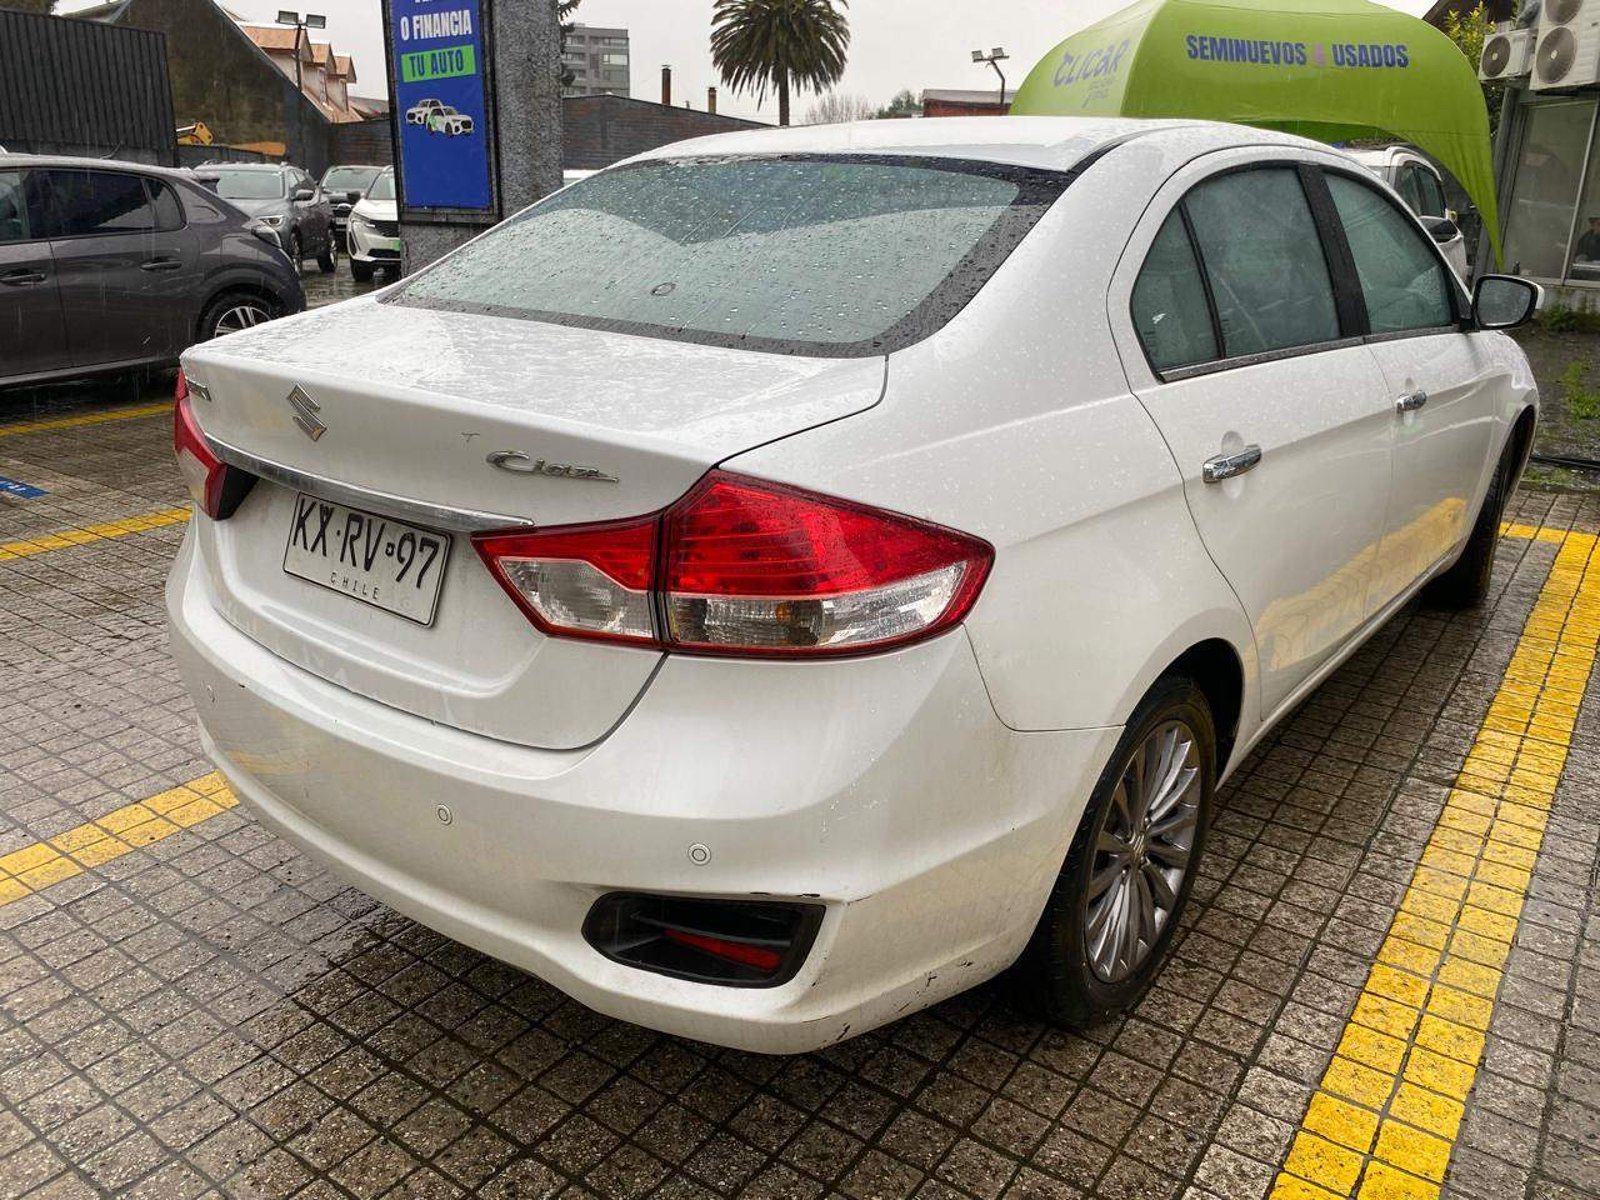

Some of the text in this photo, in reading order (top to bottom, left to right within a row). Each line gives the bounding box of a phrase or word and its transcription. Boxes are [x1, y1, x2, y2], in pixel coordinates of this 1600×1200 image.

[400, 9, 472, 41] O FINANCIA
[409, 49, 464, 78] TU AUTO
[1186, 34, 1308, 65] SEMINUEVOS
[1331, 43, 1409, 68] USADOS
[330, 572, 380, 600] CHILE
